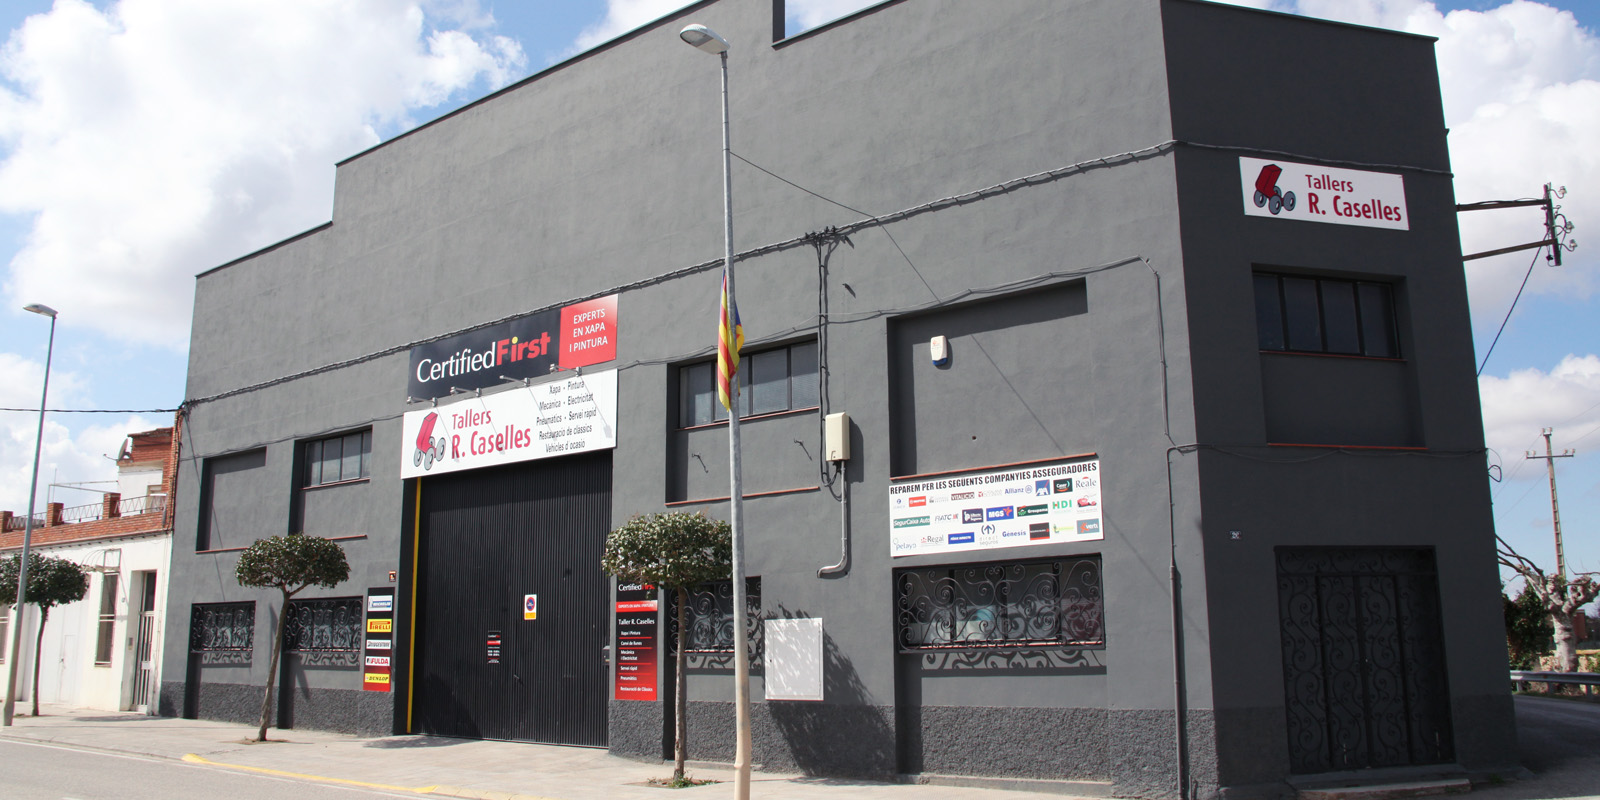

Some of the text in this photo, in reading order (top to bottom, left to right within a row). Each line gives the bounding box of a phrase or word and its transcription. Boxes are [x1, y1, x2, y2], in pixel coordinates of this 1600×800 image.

[1305, 174, 1353, 192] Tallers
[1308, 192, 1402, 222] R. Caselles
[573, 308, 606, 324] EXPERTS
[573, 322, 606, 338] EN XAPA
[573, 336, 608, 352] PINTURA
[416, 332, 551, 383] CertifiedFirst
[549, 385, 561, 396] Xapa
[568, 380, 584, 391] Pintura
[568, 392, 594, 406] Electricitat
[452, 409, 492, 430] Tallers
[568, 409, 583, 420] Servei
[566, 426, 572, 436] de
[452, 424, 531, 459] R. Caselles
[546, 442, 564, 453] Vehicles
[890, 484, 920, 494] REPAREM
[922, 482, 934, 491] PER
[936, 481, 946, 489] LES
[984, 471, 1031, 484] COMPANYIES
[1032, 462, 1097, 478] ASSEGURADORES
[1076, 478, 1096, 488] Reale
[1052, 500, 1072, 509] HDI
[927, 535, 944, 544] Regal
[370, 621, 390, 630] PIRELLI
